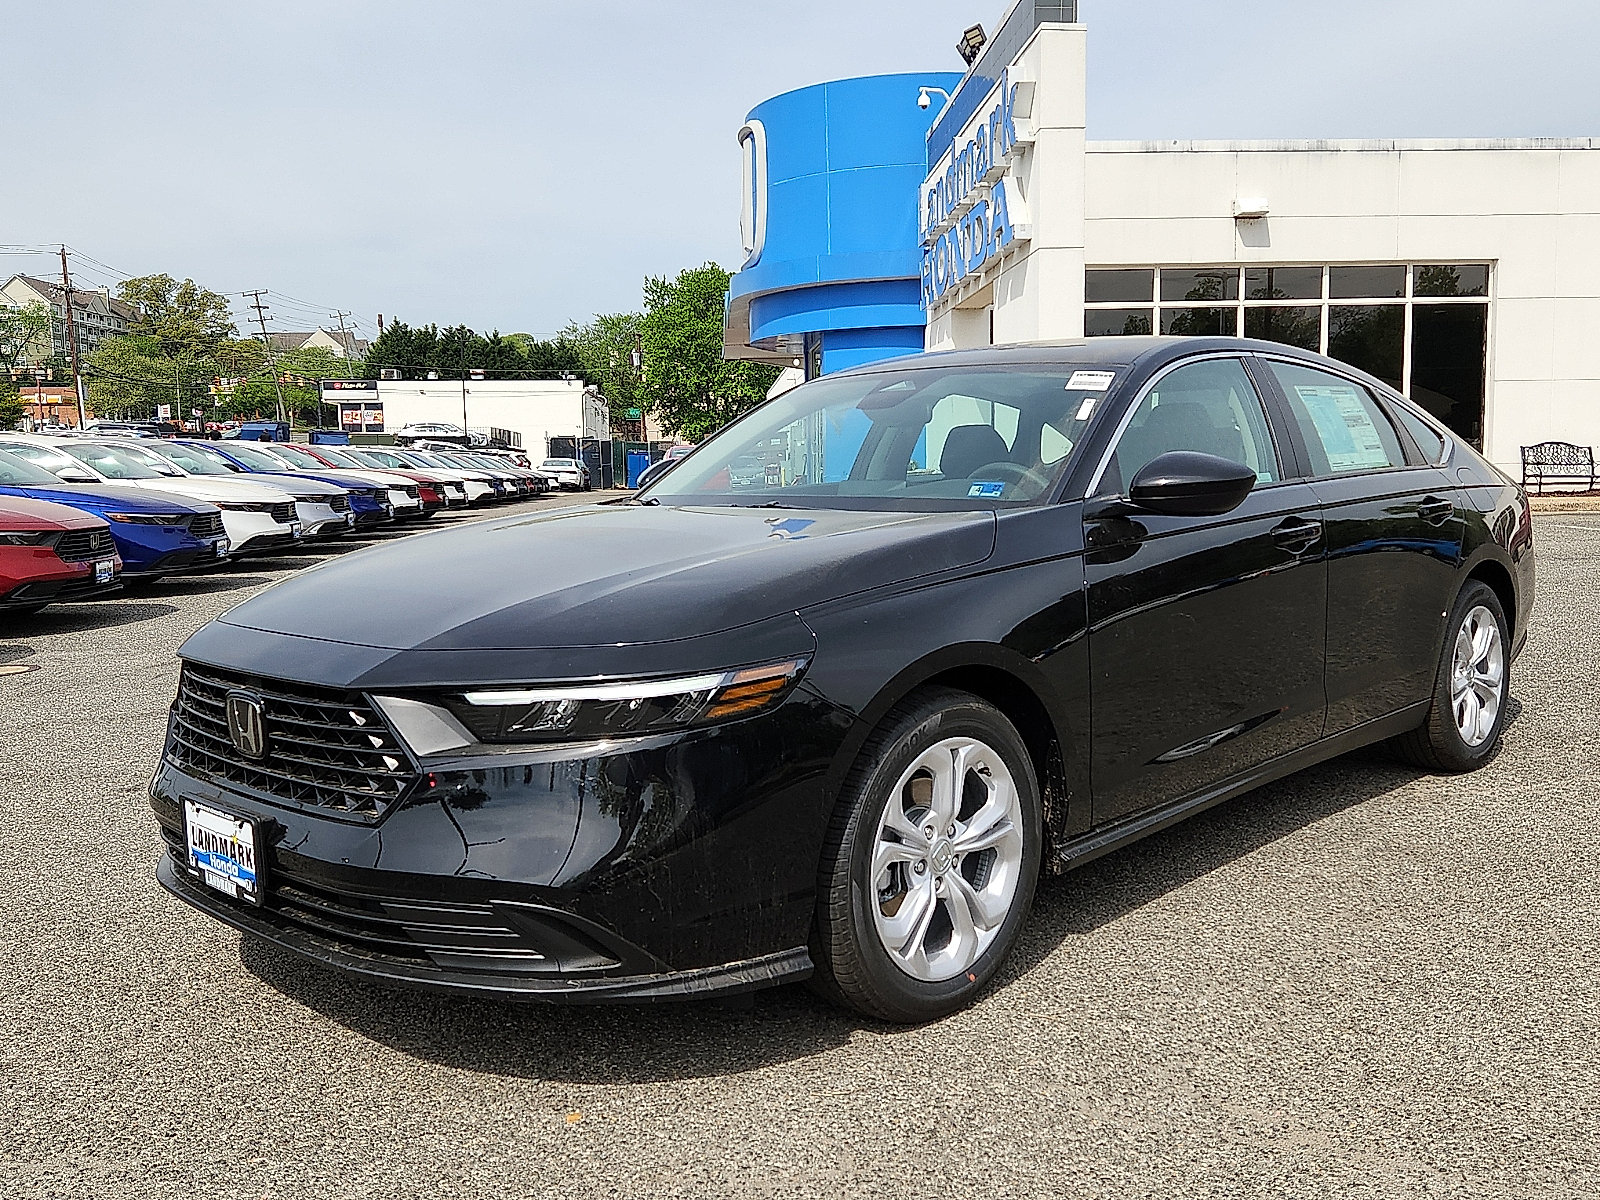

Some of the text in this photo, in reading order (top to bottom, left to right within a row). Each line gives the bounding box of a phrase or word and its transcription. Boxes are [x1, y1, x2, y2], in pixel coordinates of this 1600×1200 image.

[918, 65, 1018, 248] Landmark
[920, 176, 1014, 311] HONDA
[191, 824, 255, 870] LANDMARK
[209, 853, 239, 877] Honda
